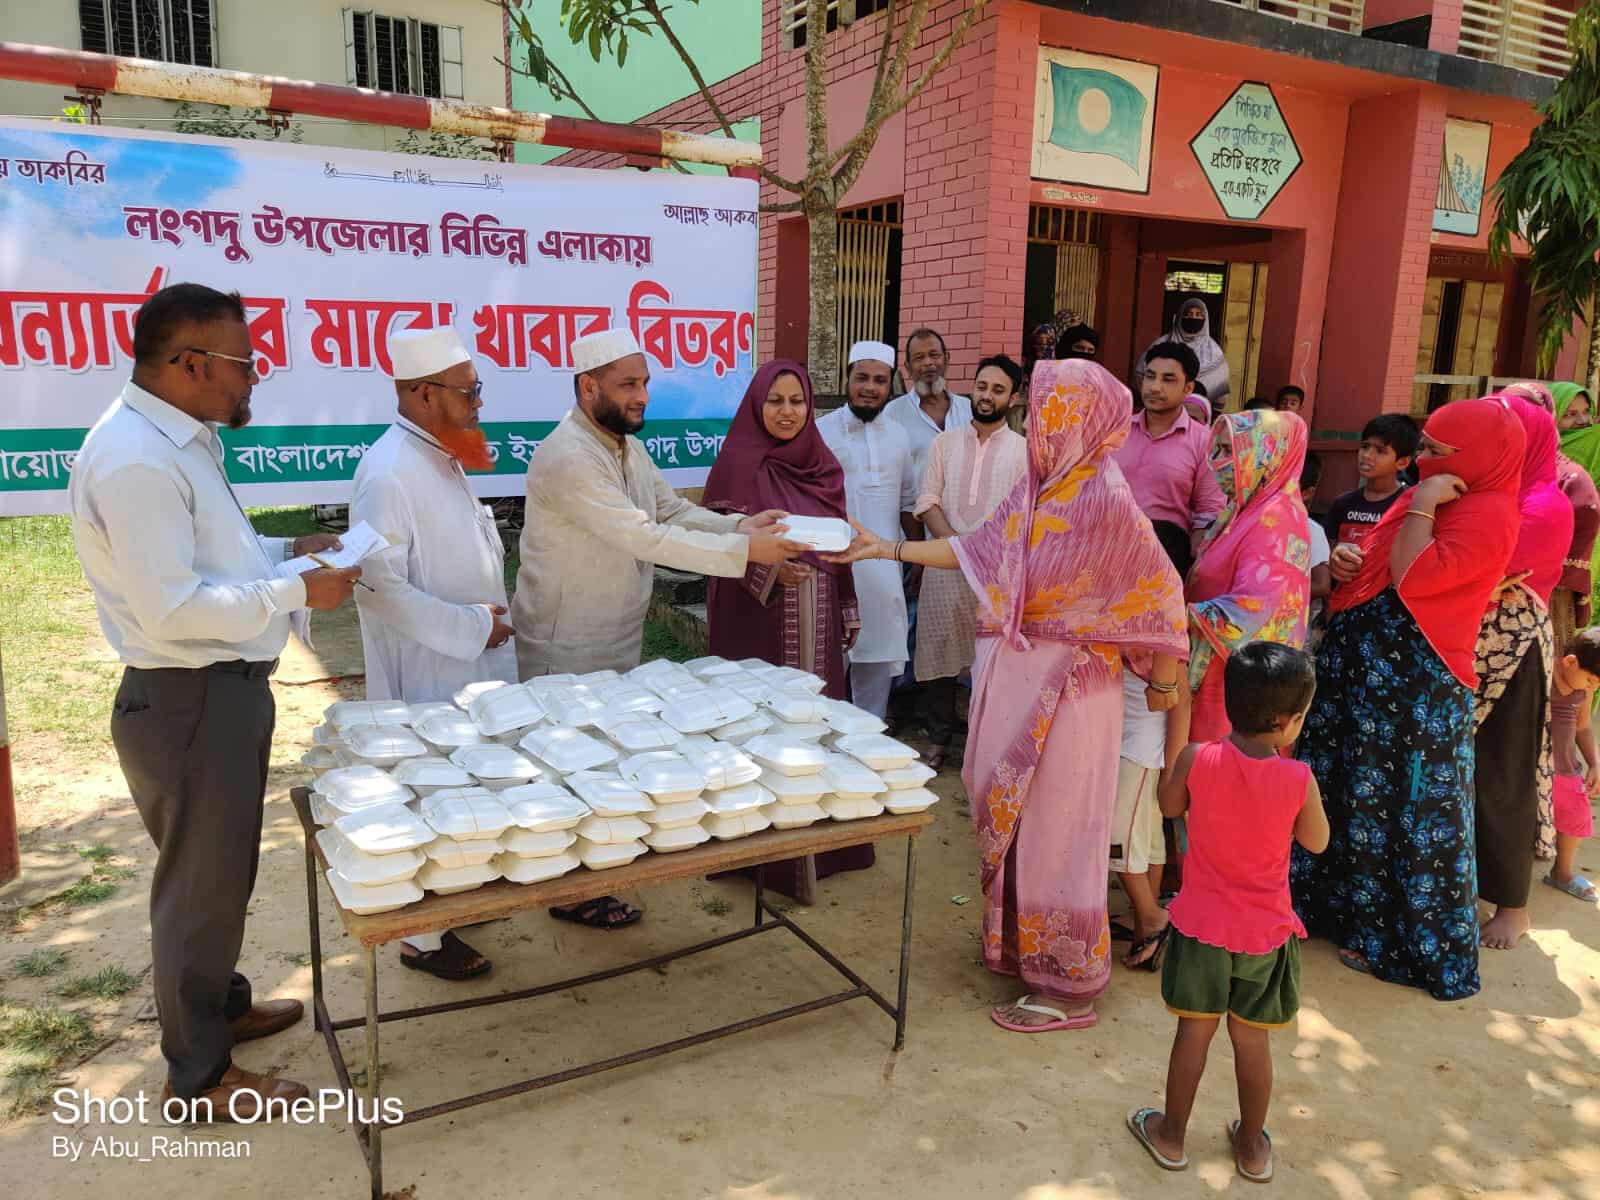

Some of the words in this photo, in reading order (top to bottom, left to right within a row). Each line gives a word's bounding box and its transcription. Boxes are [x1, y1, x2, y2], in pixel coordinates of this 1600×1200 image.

[15, 150, 105, 186] তাকবির
[1210, 147, 1244, 170] প্রতিটি
[1260, 158, 1281, 176] হবে
[663, 204, 710, 226] আল্লাহু
[123, 206, 251, 262] লংগদু
[252, 205, 429, 257] উপজেলার
[440, 212, 527, 265] বিভিন্ন
[537, 231, 652, 267] এলাকায়
